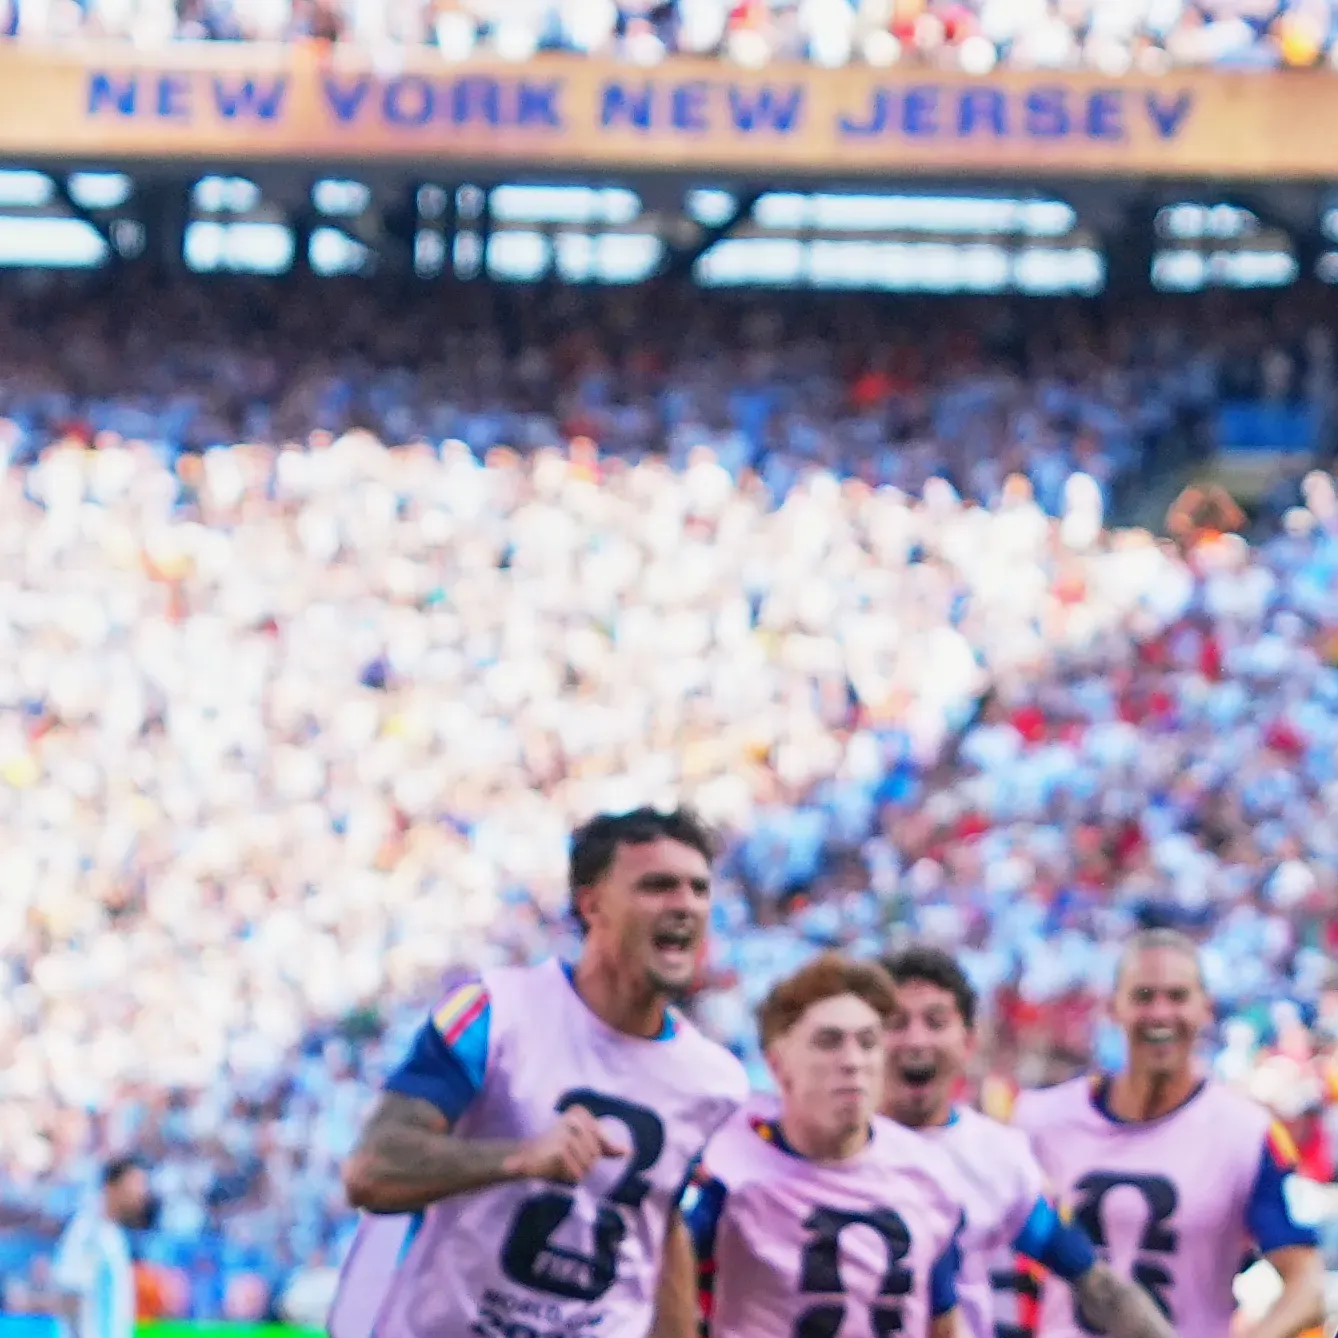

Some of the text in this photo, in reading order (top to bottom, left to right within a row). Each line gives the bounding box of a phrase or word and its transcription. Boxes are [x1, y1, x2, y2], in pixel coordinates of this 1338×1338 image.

[86, 71, 1194, 140] NEW YORK NEW JERSEY
